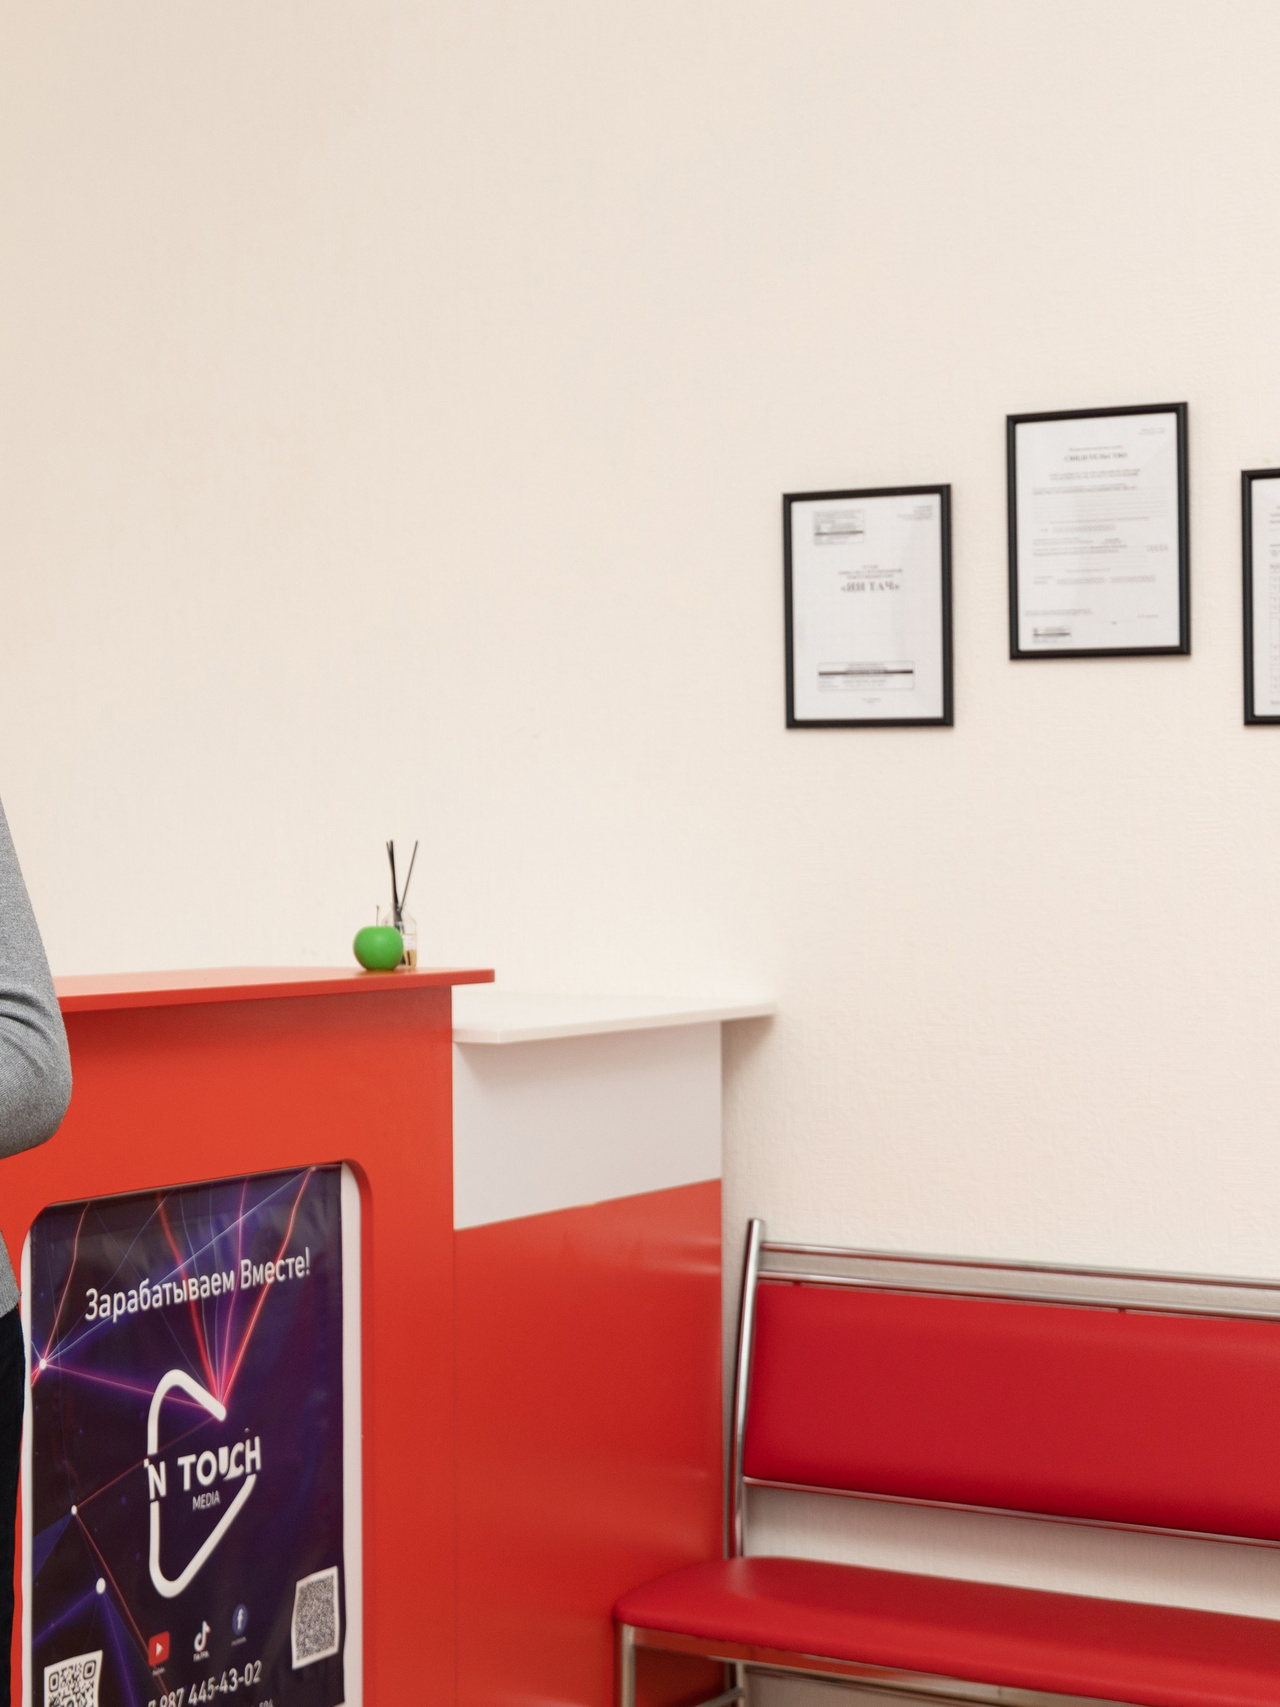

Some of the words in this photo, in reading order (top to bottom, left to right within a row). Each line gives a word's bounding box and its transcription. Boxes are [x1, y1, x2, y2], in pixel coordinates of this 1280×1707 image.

[84, 1269, 235, 1324] Зарабатываем
[240, 1247, 310, 1290] Вместе!
[177, 1436, 261, 1491] TOUCH
[192, 1490, 220, 1511] MEDIA
[188, 1660, 262, 1706] 445-43-02
